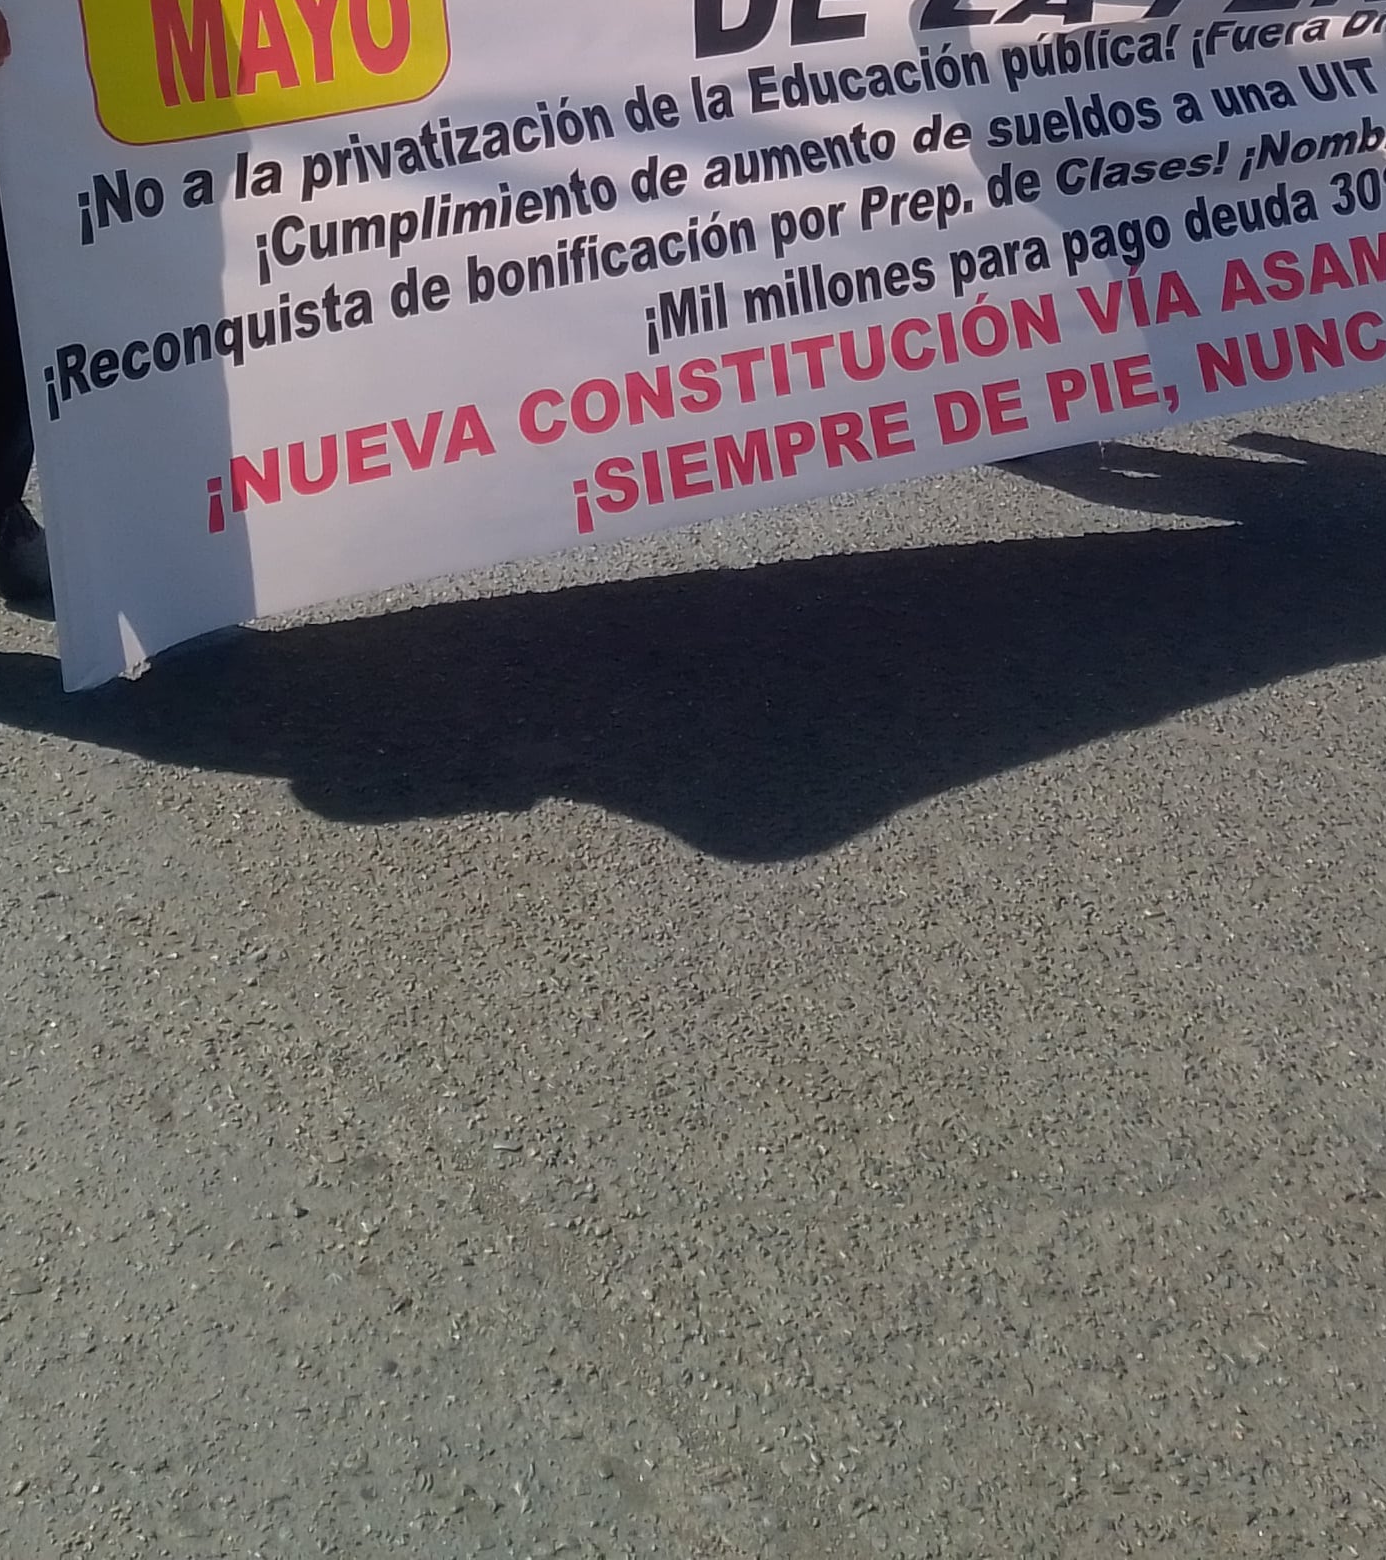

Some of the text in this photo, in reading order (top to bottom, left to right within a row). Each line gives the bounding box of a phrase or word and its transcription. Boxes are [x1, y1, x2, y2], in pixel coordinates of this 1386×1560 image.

[77, 167, 165, 246] ¡No
[182, 168, 215, 209] a
[234, 150, 283, 201] la
[300, 96, 615, 202] privatización
[623, 83, 681, 133] de
[690, 76, 735, 125] la
[747, 42, 992, 113] Educación
[1002, 23, 1178, 94] pública!
[1190, 16, 1327, 71] ¡Fuera
[253, 166, 619, 287] ¡Cumplimiento
[630, 154, 689, 204] de
[702, 119, 898, 189] aumento
[911, 111, 975, 156] de
[986, 91, 1164, 149] sueldos
[1174, 88, 1206, 125] a
[1209, 75, 1299, 120] una
[1297, 56, 1381, 104] UIT
[41, 280, 375, 423] ¡Reconquista
[390, 265, 453, 319] de
[466, 210, 755, 306] bonificación
[769, 197, 848, 259] por
[859, 186, 975, 233] Prep.
[986, 161, 1043, 208] de
[1054, 138, 1230, 196] Clases!
[644, 283, 729, 354] ¡Mil
[742, 255, 938, 327] millones
[948, 237, 1052, 299] para
[1062, 212, 1173, 277] pago
[1182, 180, 1320, 244] deuda
[207, 403, 498, 535] ¡NUEVA
[518, 292, 1062, 445] CONSTITUCIÓN
[1079, 265, 1201, 334] VÍA
[572, 400, 917, 535] ¡SIEMPRE
[933, 380, 1029, 446] DE
[1045, 354, 1181, 422] PIE,
